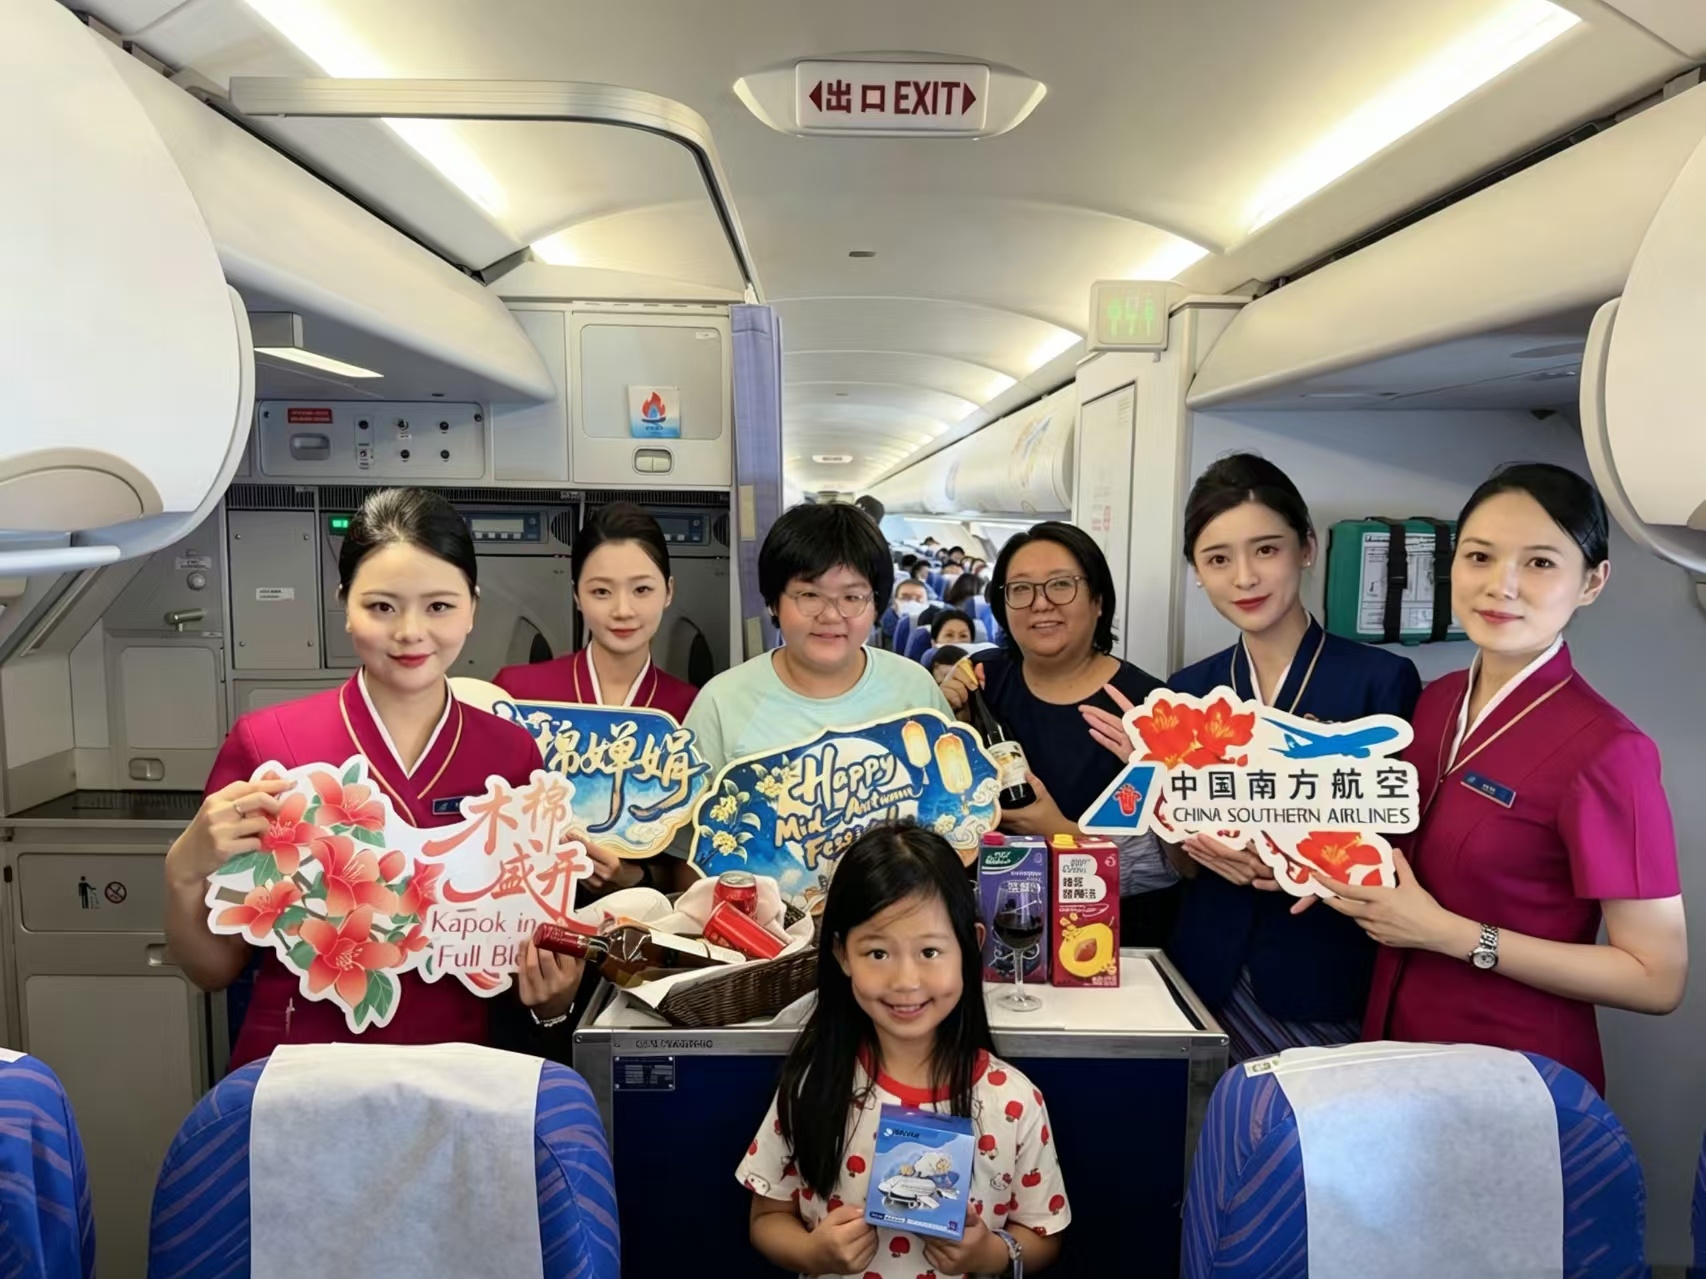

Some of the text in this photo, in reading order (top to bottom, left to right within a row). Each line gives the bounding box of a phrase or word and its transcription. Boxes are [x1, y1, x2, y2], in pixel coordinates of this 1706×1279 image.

[826, 79, 885, 114] 出口
[894, 81, 960, 115] EXIT
[788, 743, 897, 811] Happy
[1171, 766, 1410, 800] 中国南方航空
[421, 778, 567, 857] 木棉
[1173, 807, 1411, 824] CHINA SOUTHERN AIRLINES
[443, 840, 598, 936] 盛开
[431, 911, 537, 941] Kapok in
[438, 944, 482, 968] Full
